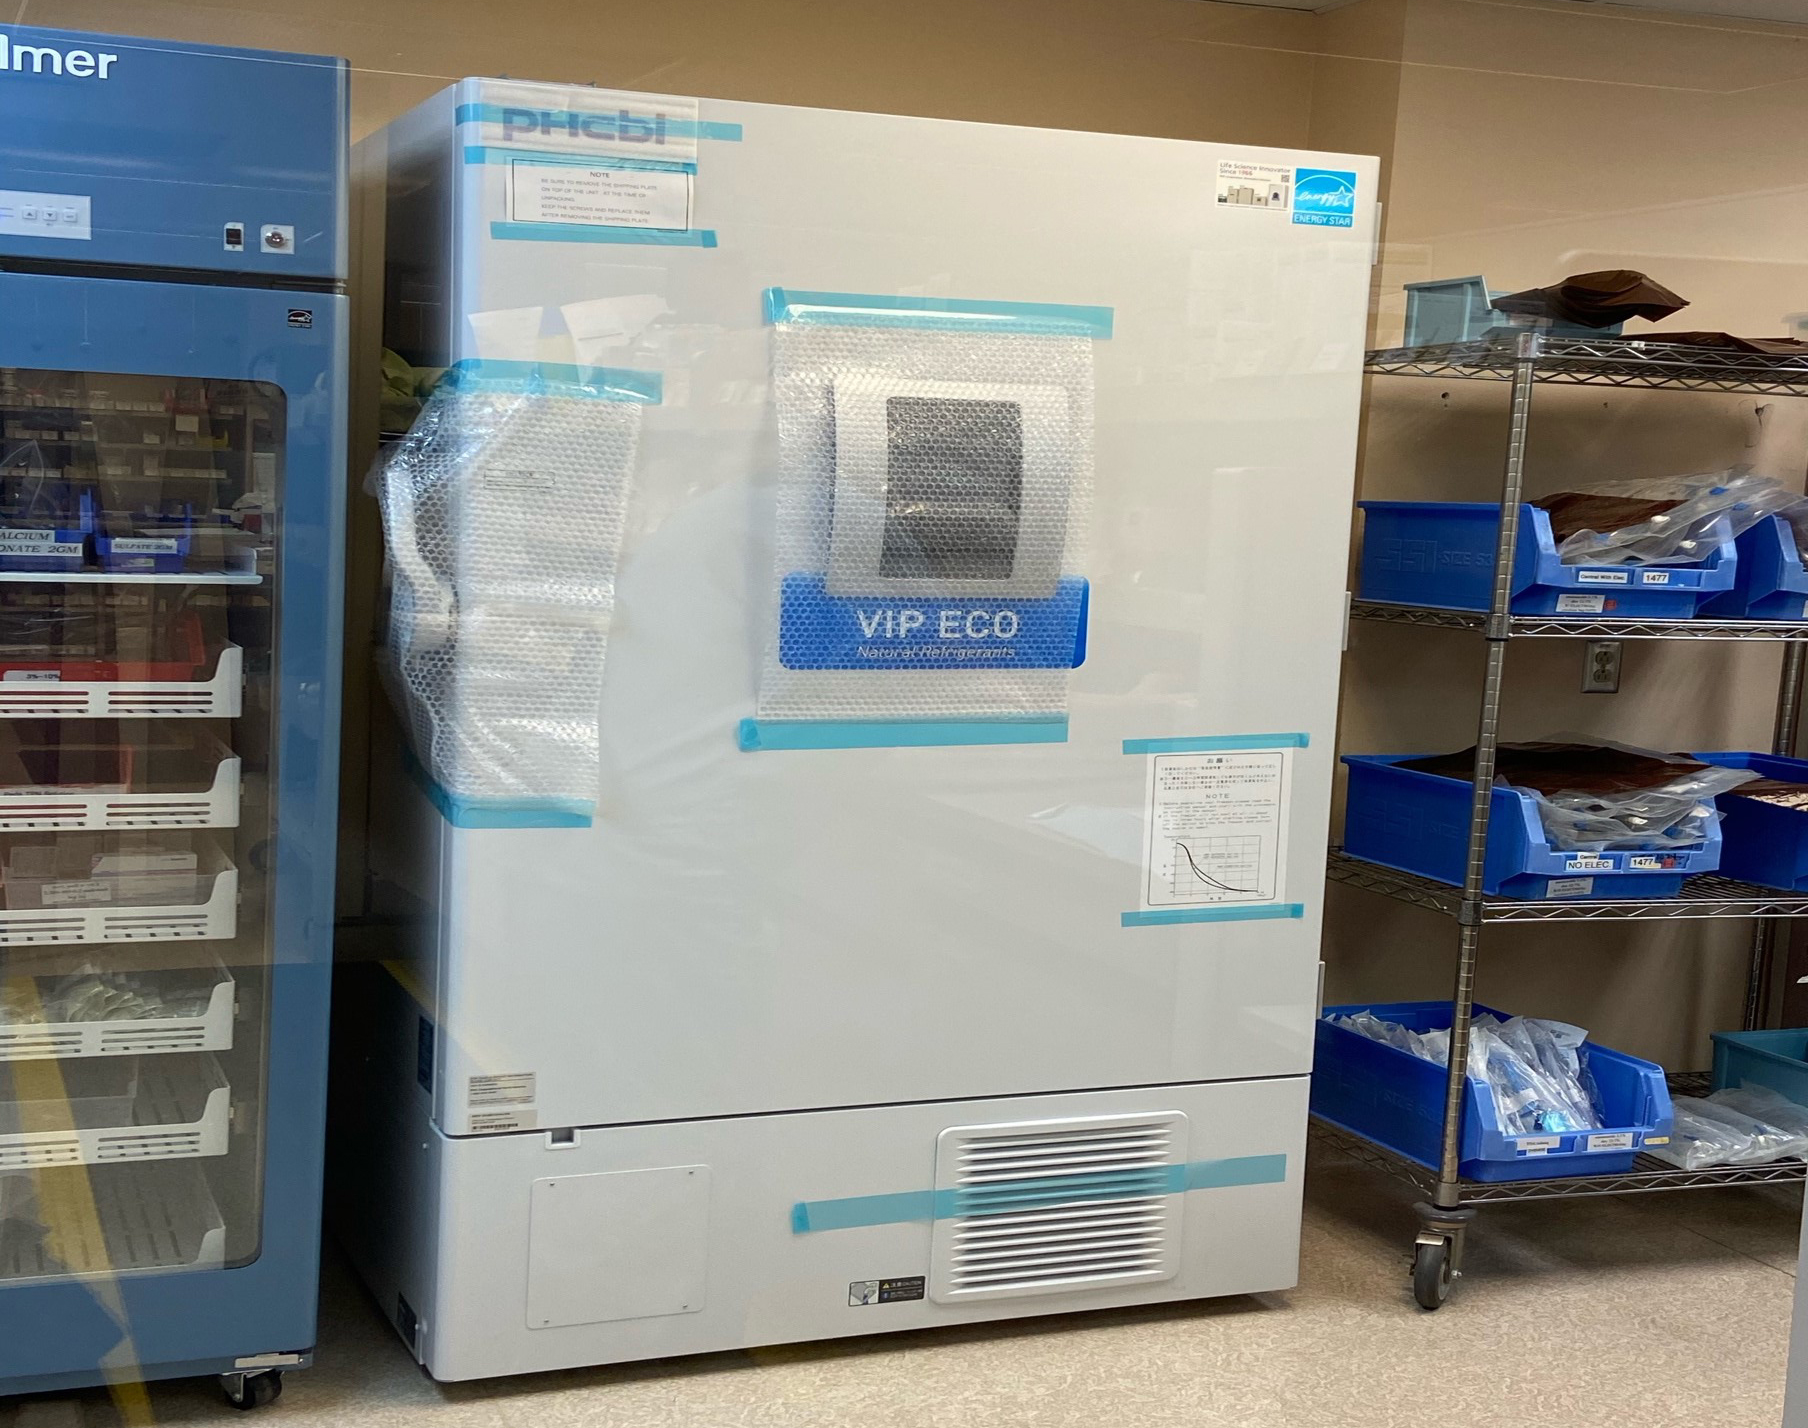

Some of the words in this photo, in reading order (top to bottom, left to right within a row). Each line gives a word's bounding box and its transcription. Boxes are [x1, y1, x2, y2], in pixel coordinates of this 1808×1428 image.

[1294, 213, 1328, 224] ENERGY
[1329, 215, 1351, 226] STAR
[48, 545, 78, 554] 2GM
[1645, 574, 1667, 582] 1477
[856, 610, 924, 638] VIP
[939, 610, 1018, 638] ECO
[857, 645, 914, 659] Natural
[920, 645, 1016, 661] Refrigerants
[1568, 861, 1583, 869] NO
[1633, 858, 1653, 866] 1477
